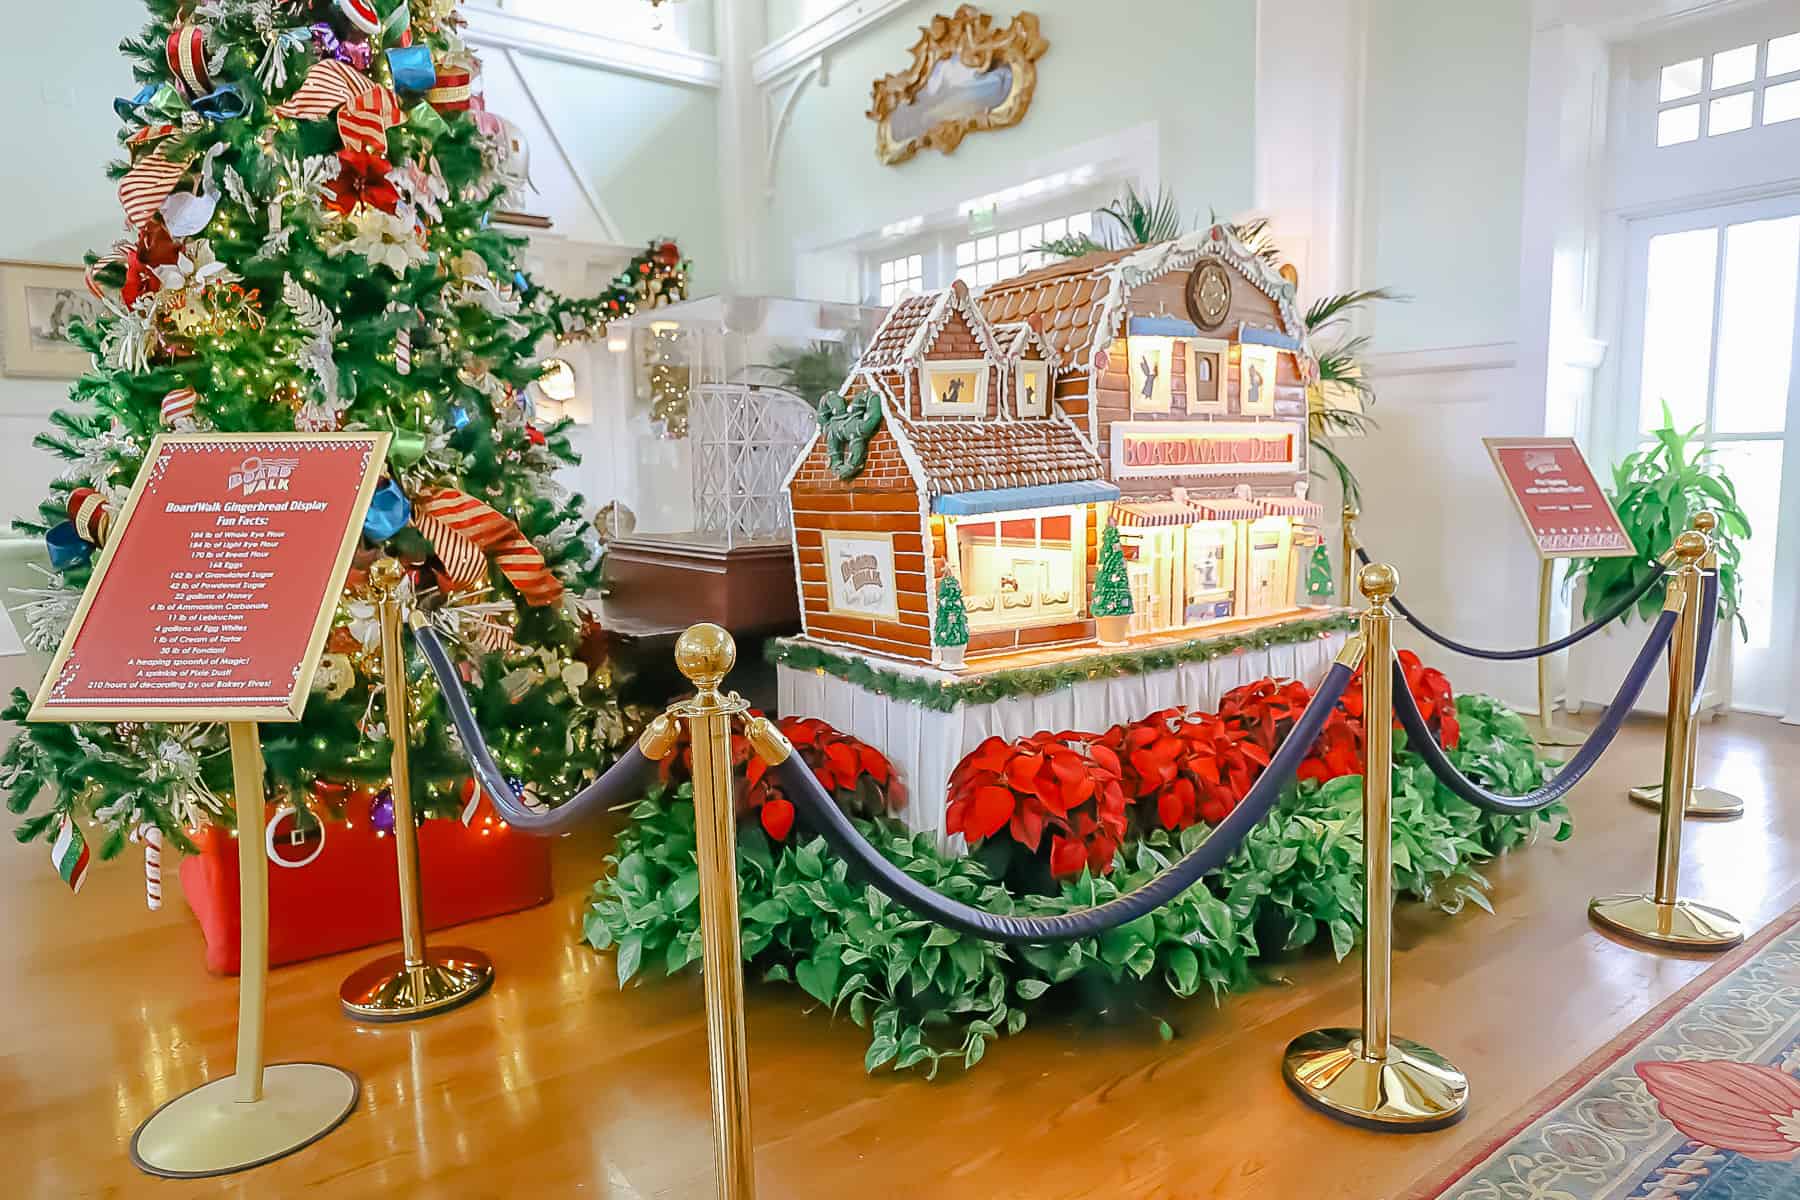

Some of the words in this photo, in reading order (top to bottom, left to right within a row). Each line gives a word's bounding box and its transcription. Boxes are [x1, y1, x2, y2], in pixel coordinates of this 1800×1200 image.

[228, 467, 293, 491] BOARD
[243, 477, 290, 497] WALK
[165, 501, 221, 514] BoardWalk
[223, 500, 288, 515] Gingerbread
[289, 500, 328, 513] Display
[216, 515, 236, 526] Fun
[237, 515, 269, 526] Facts:
[214, 531, 223, 539] of
[223, 531, 248, 539] Whole
[249, 531, 265, 540] Rye
[213, 541, 222, 549] of
[222, 541, 242, 549] Light
[242, 541, 258, 549] Rye
[259, 540, 279, 548] Flour
[191, 551, 204, 559] 170
[223, 561, 243, 570] Eggs
[250, 571, 274, 579] Sugar
[242, 582, 267, 590] Sugar
[185, 593, 216, 601] gallons
[226, 592, 254, 600] Honey
[176, 602, 224, 610] Ammonium
[161, 625, 192, 633] gallons
[193, 624, 203, 632] of
[203, 625, 219, 633] Egg
[179, 635, 208, 643] Cream
[209, 635, 219, 643] of
[192, 646, 226, 654] Fondant
[135, 658, 172, 666] heaping
[173, 658, 208, 666] spoonful
[219, 658, 250, 666] Magic!
[145, 670, 178, 678] sprinkle
[179, 669, 189, 677] of
[189, 669, 209, 677] Pixie
[87, 681, 103, 689] 210
[103, 681, 128, 689] hours
[129, 681, 139, 689] of
[139, 680, 186, 689] decorating
[187, 680, 200, 689] by
[216, 680, 246, 688] Bakery
[247, 679, 272, 688] Elves!
